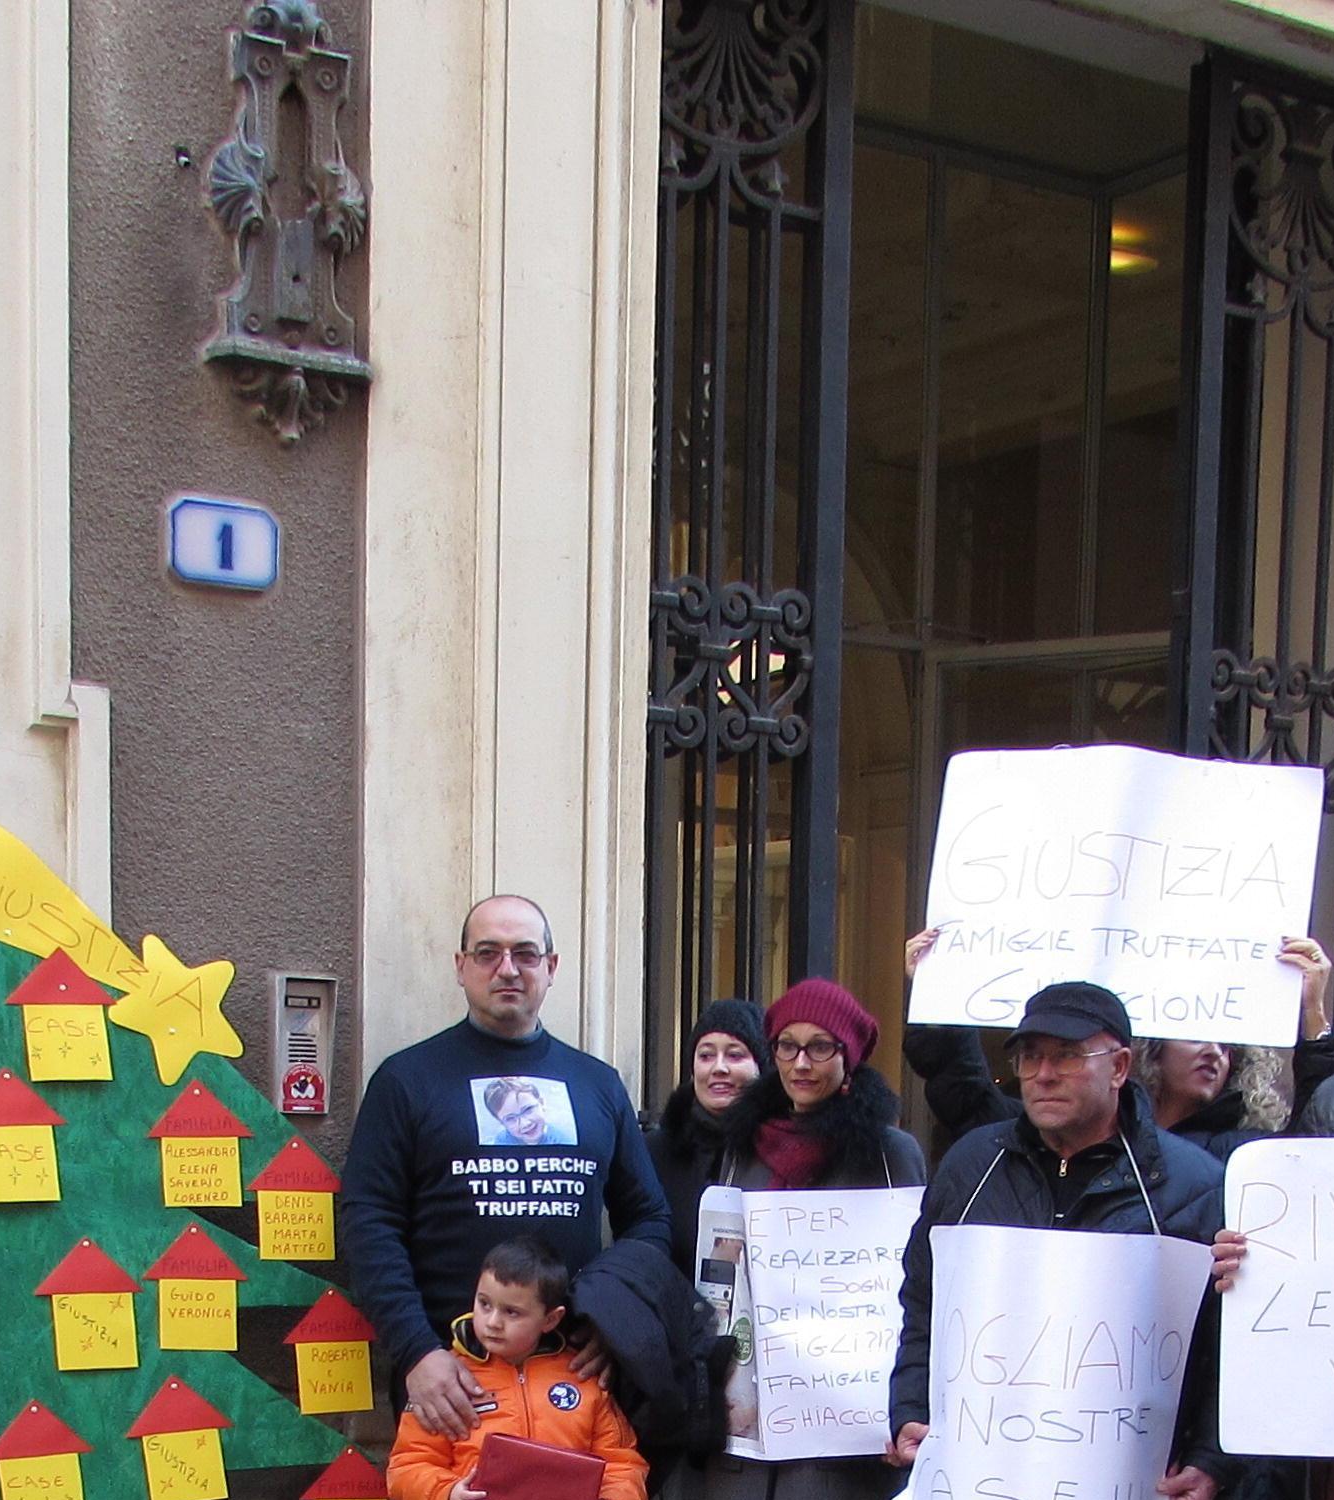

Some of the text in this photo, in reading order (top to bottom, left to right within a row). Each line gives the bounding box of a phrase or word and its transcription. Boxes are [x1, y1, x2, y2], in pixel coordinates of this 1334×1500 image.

[218, 524, 233, 571] 1
[946, 805, 1286, 907] GIUSTIZIA
[1091, 927, 1268, 961] TRUFFATE
[26, 1017, 100, 1037] CASE
[165, 1144, 237, 1158] ALESSANDRO
[179, 1163, 218, 1174] ELENA
[452, 1157, 598, 1175] BABBO PERCHE'
[169, 1178, 222, 1188] SAVERIO
[469, 1179, 585, 1196] TI SEI FATTO
[174, 1192, 228, 1203] LORENZO
[276, 1197, 314, 1209] DENIS
[475, 1201, 580, 1217] TRUFFARE?
[265, 1212, 324, 1225] BARBARA
[749, 1207, 848, 1237] E PER
[274, 1229, 317, 1239] MARTA
[272, 1243, 326, 1254] MATTEO
[750, 1245, 906, 1270] REALIZZARE
[161, 1258, 229, 1273] FAMIGLIA
[171, 1287, 215, 1301] GUIDO
[169, 1308, 232, 1318] VERONICA
[1251, 1282, 1332, 1332] LE
[311, 1348, 365, 1362] ROBERTO
[307, 1379, 354, 1394] VANIA
[958, 1395, 1151, 1445] NOSTRE
[146, 1436, 210, 1491] GIUSTIZIA
[7, 1476, 64, 1489] CASE
